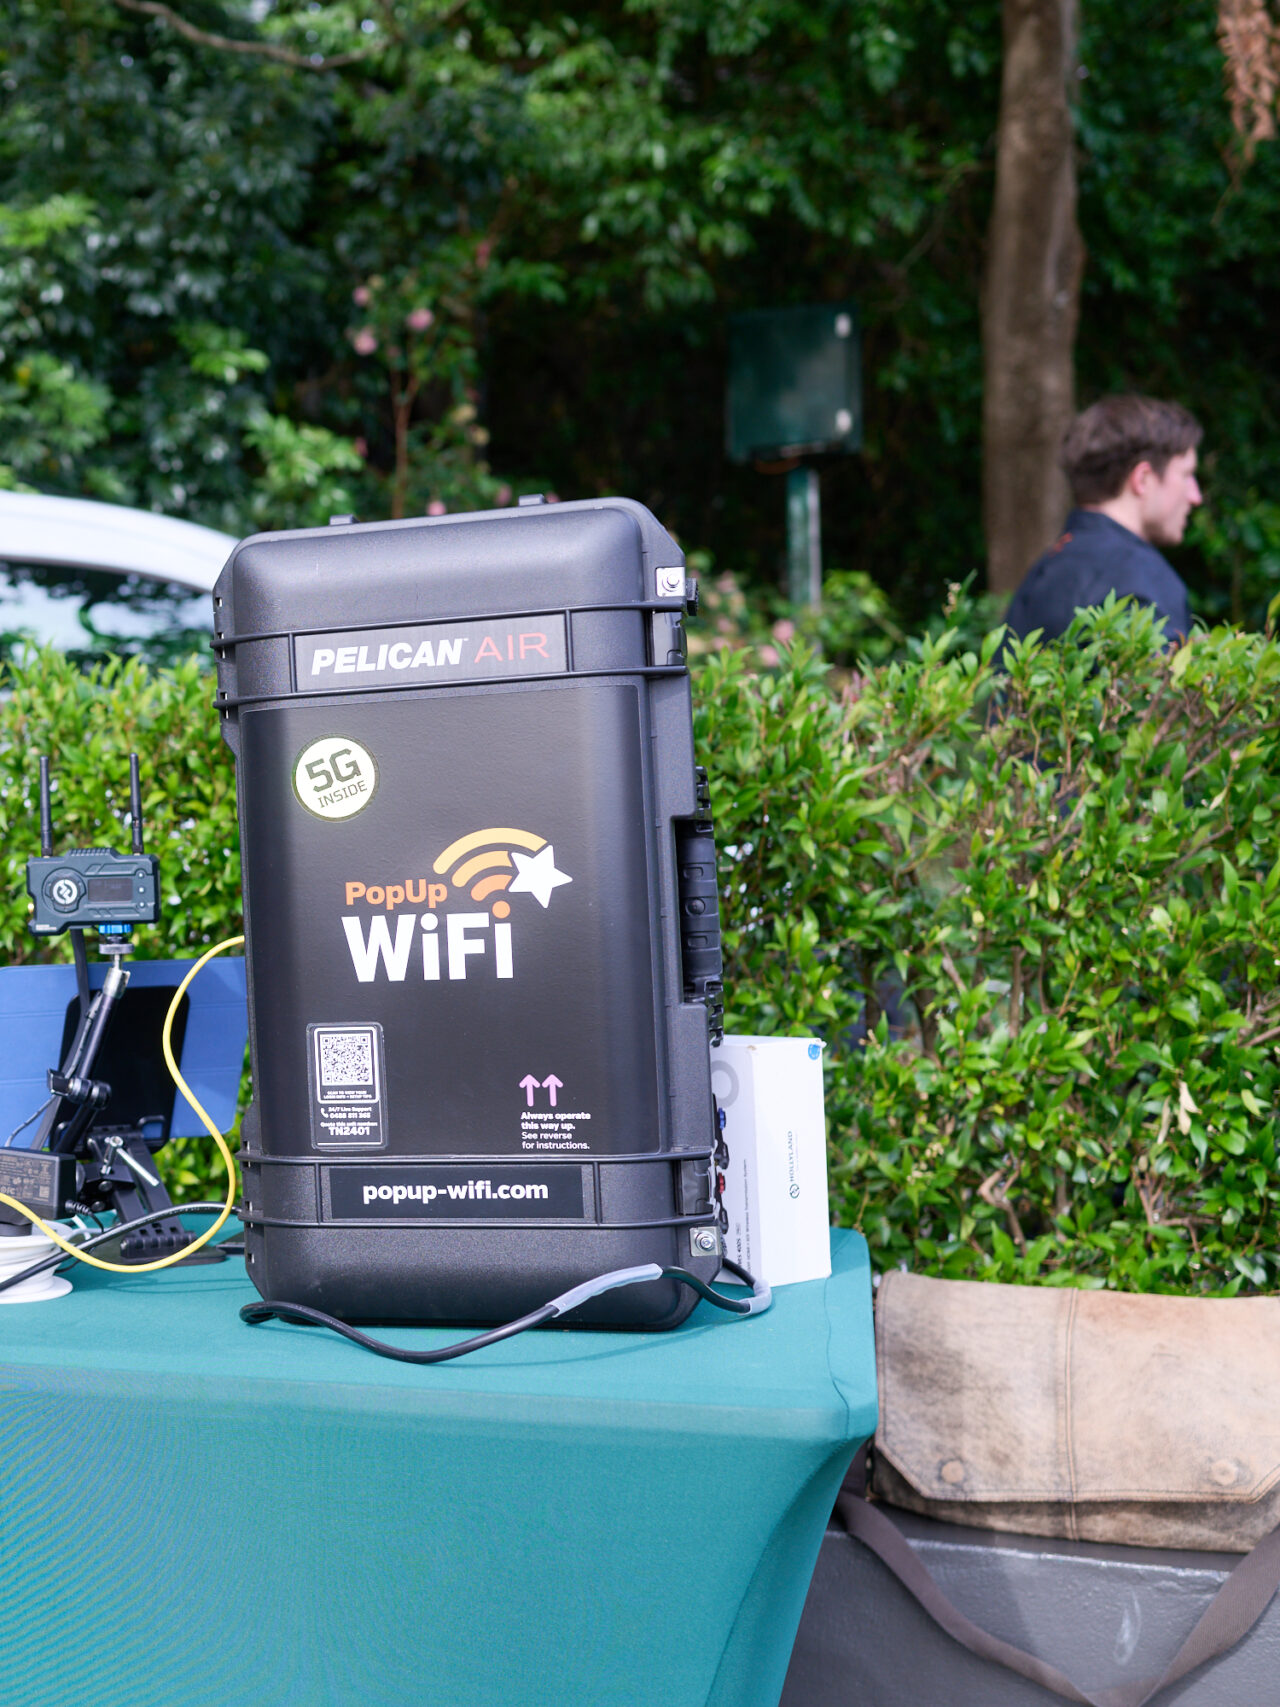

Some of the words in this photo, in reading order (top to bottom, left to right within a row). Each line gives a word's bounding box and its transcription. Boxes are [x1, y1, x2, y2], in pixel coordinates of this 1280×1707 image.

[311, 638, 463, 676] PELICAN
[474, 632, 550, 664] AIR
[304, 748, 362, 793] 5G
[317, 780, 368, 809] INSIDE
[345, 879, 448, 910] PopUp
[341, 900, 514, 982] WiFi
[521, 1112, 554, 1121] Always
[555, 1112, 591, 1121] operate
[521, 1121, 538, 1130] this
[540, 1122, 559, 1131] way
[560, 1122, 576, 1131] up.
[328, 1126, 370, 1135] TN2401
[522, 1132, 538, 1140] See
[539, 1132, 573, 1140] reverse
[522, 1141, 535, 1149] for
[536, 1141, 590, 1149] instructions.
[787, 1130, 795, 1182] HOLLYLAND
[363, 1181, 549, 1205] popup-wifi.com
